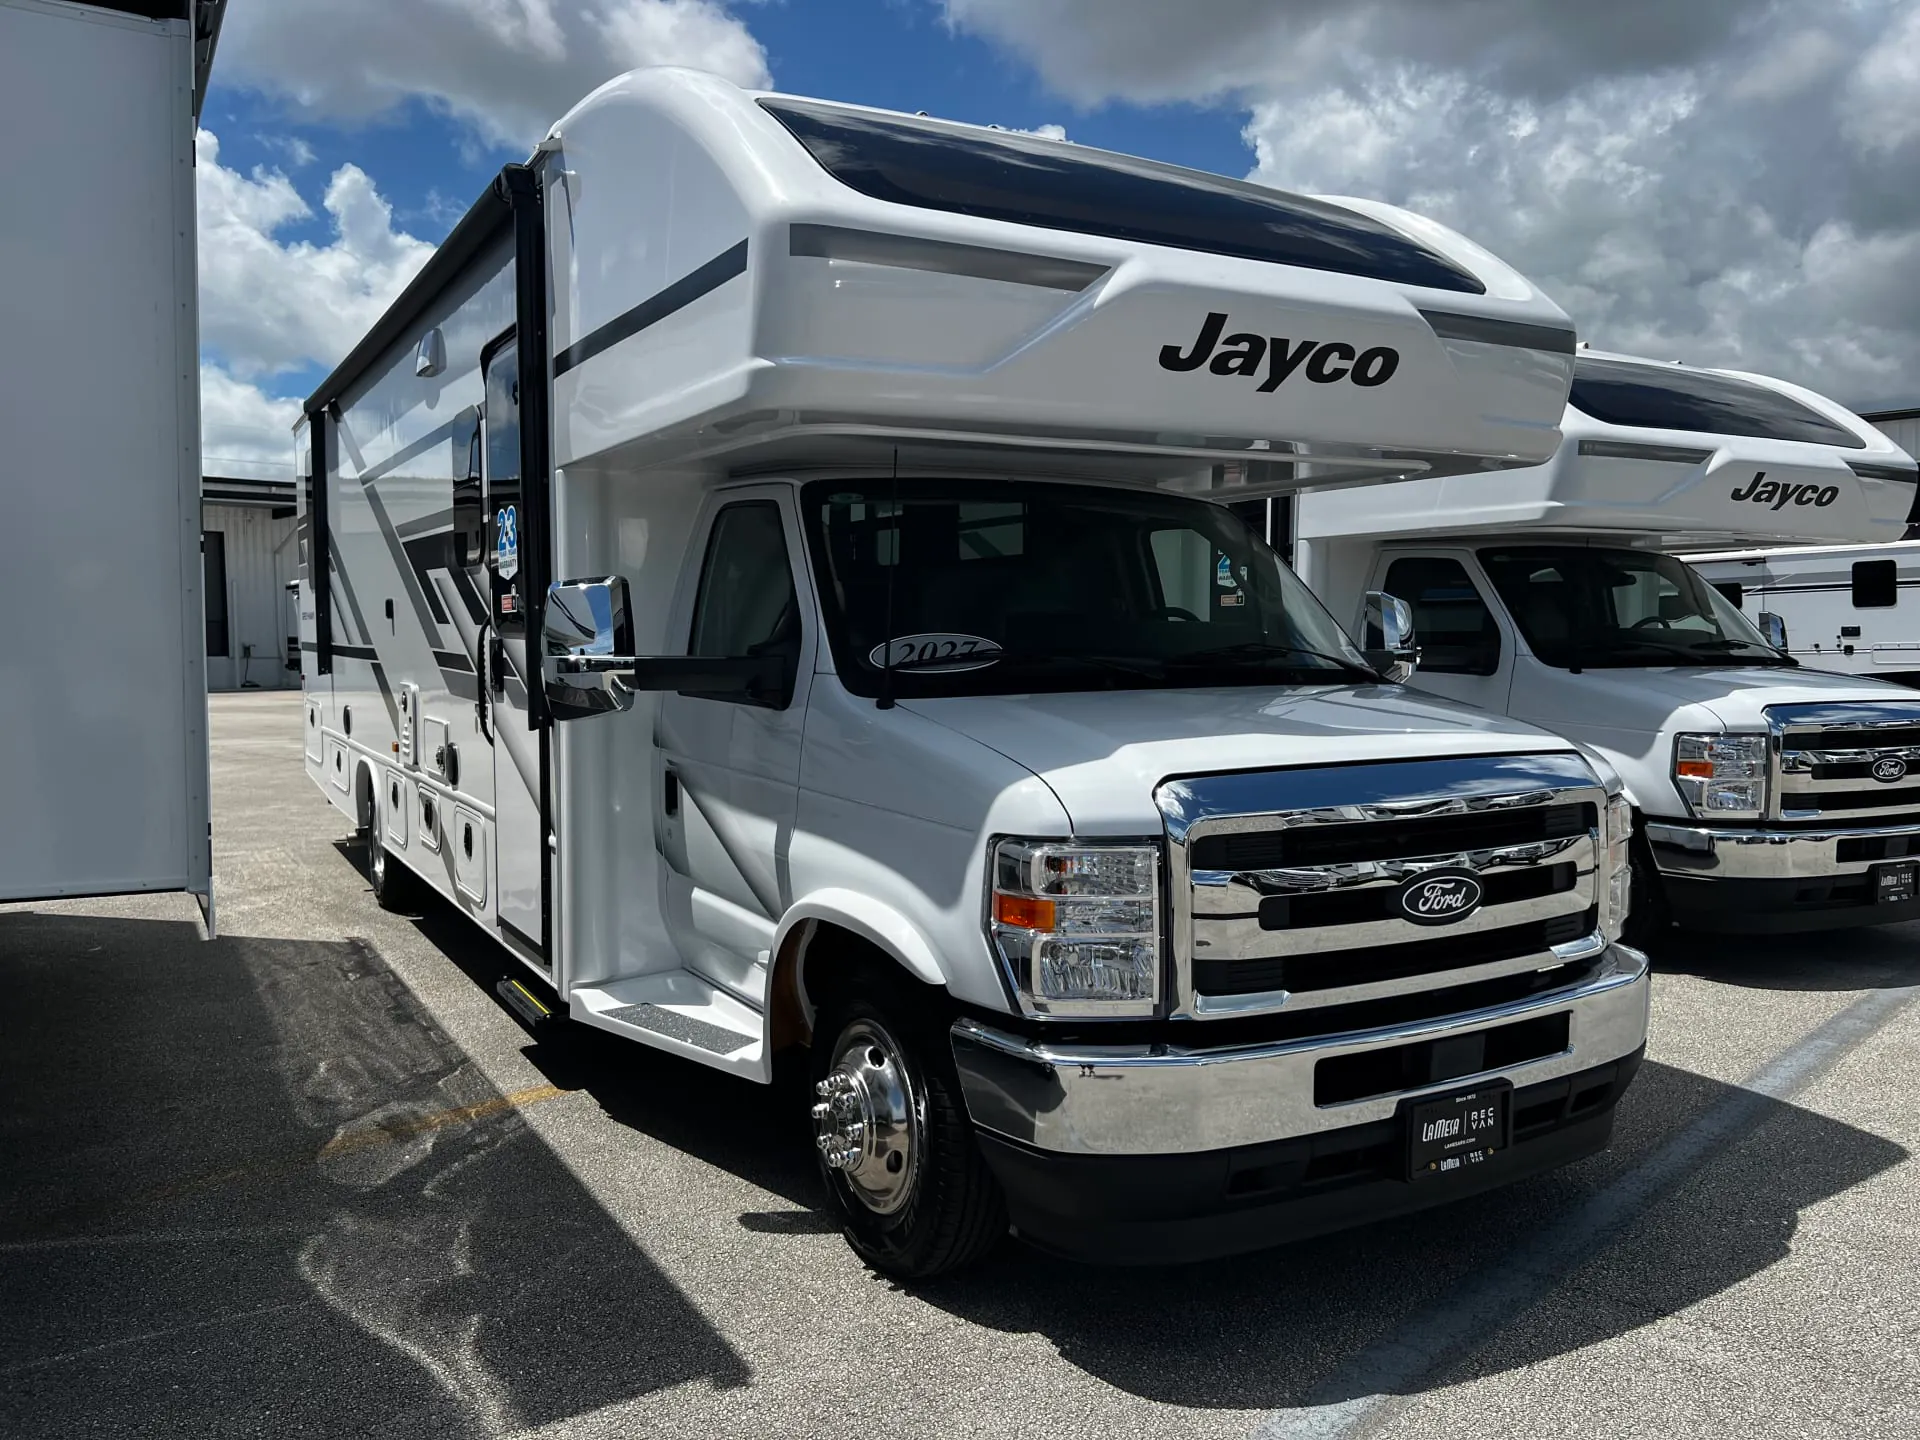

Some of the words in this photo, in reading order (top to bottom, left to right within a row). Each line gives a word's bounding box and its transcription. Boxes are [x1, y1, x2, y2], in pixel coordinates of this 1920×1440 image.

[1158, 311, 1400, 393] Jayco
[1730, 471, 1839, 511] Jayco
[1879, 761, 1901, 776] Ford
[1418, 882, 1467, 912] Ford
[1471, 1107, 1494, 1121] REC
[1471, 1117, 1494, 1130] VAN
